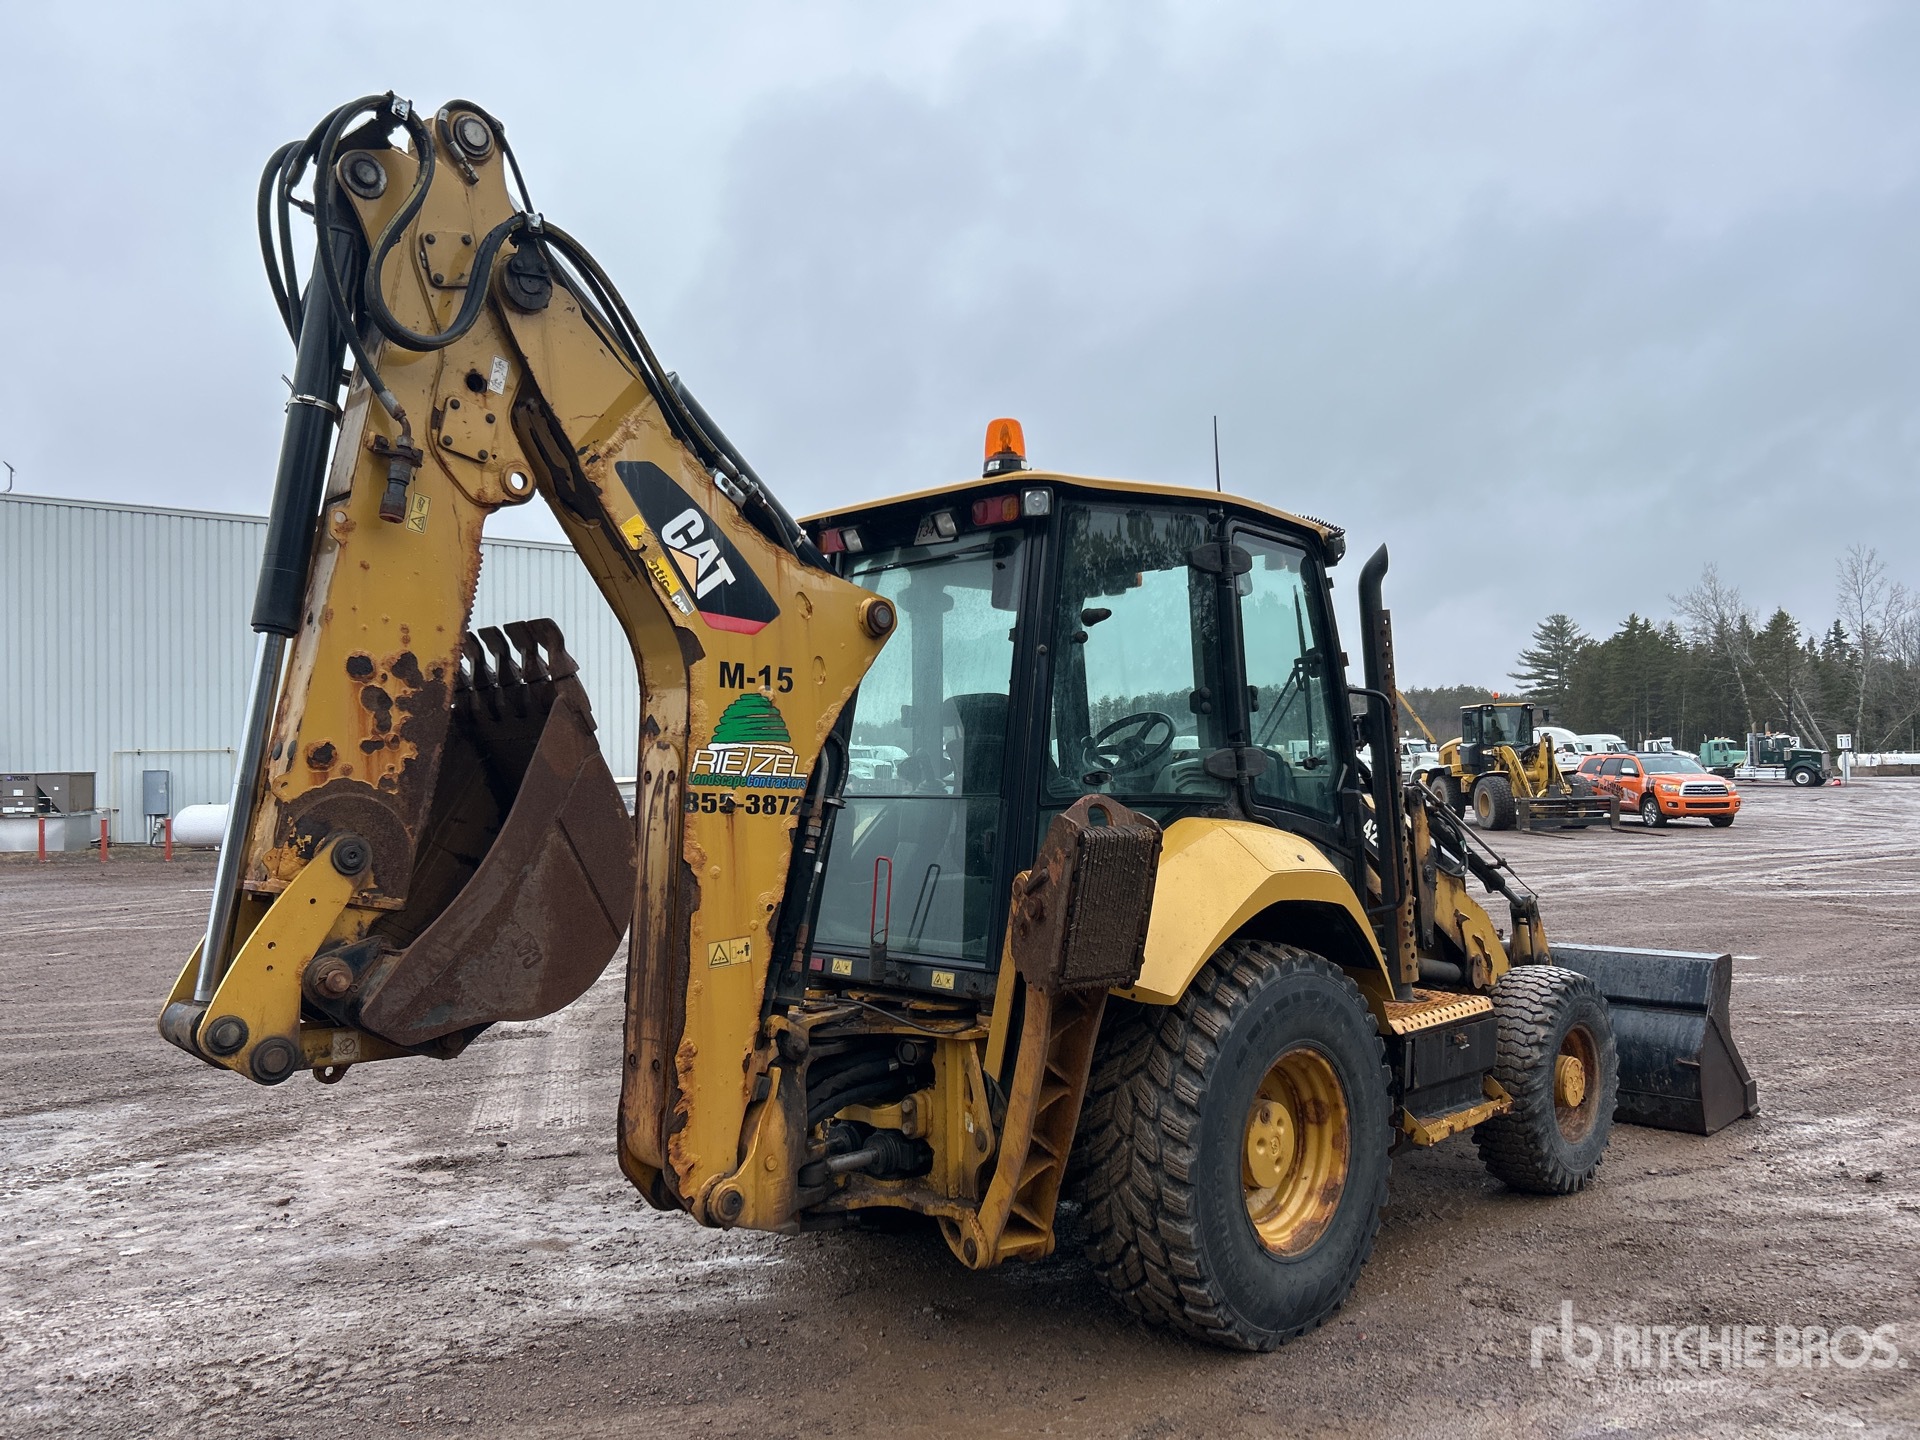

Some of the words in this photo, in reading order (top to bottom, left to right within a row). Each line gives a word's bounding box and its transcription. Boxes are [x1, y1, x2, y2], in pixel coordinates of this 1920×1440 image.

[661, 508, 736, 600] CAT
[719, 661, 794, 693] M-15
[691, 747, 808, 778] RIETZEL
[685, 792, 803, 815] 855-3872
[1363, 818, 1379, 848] 42
